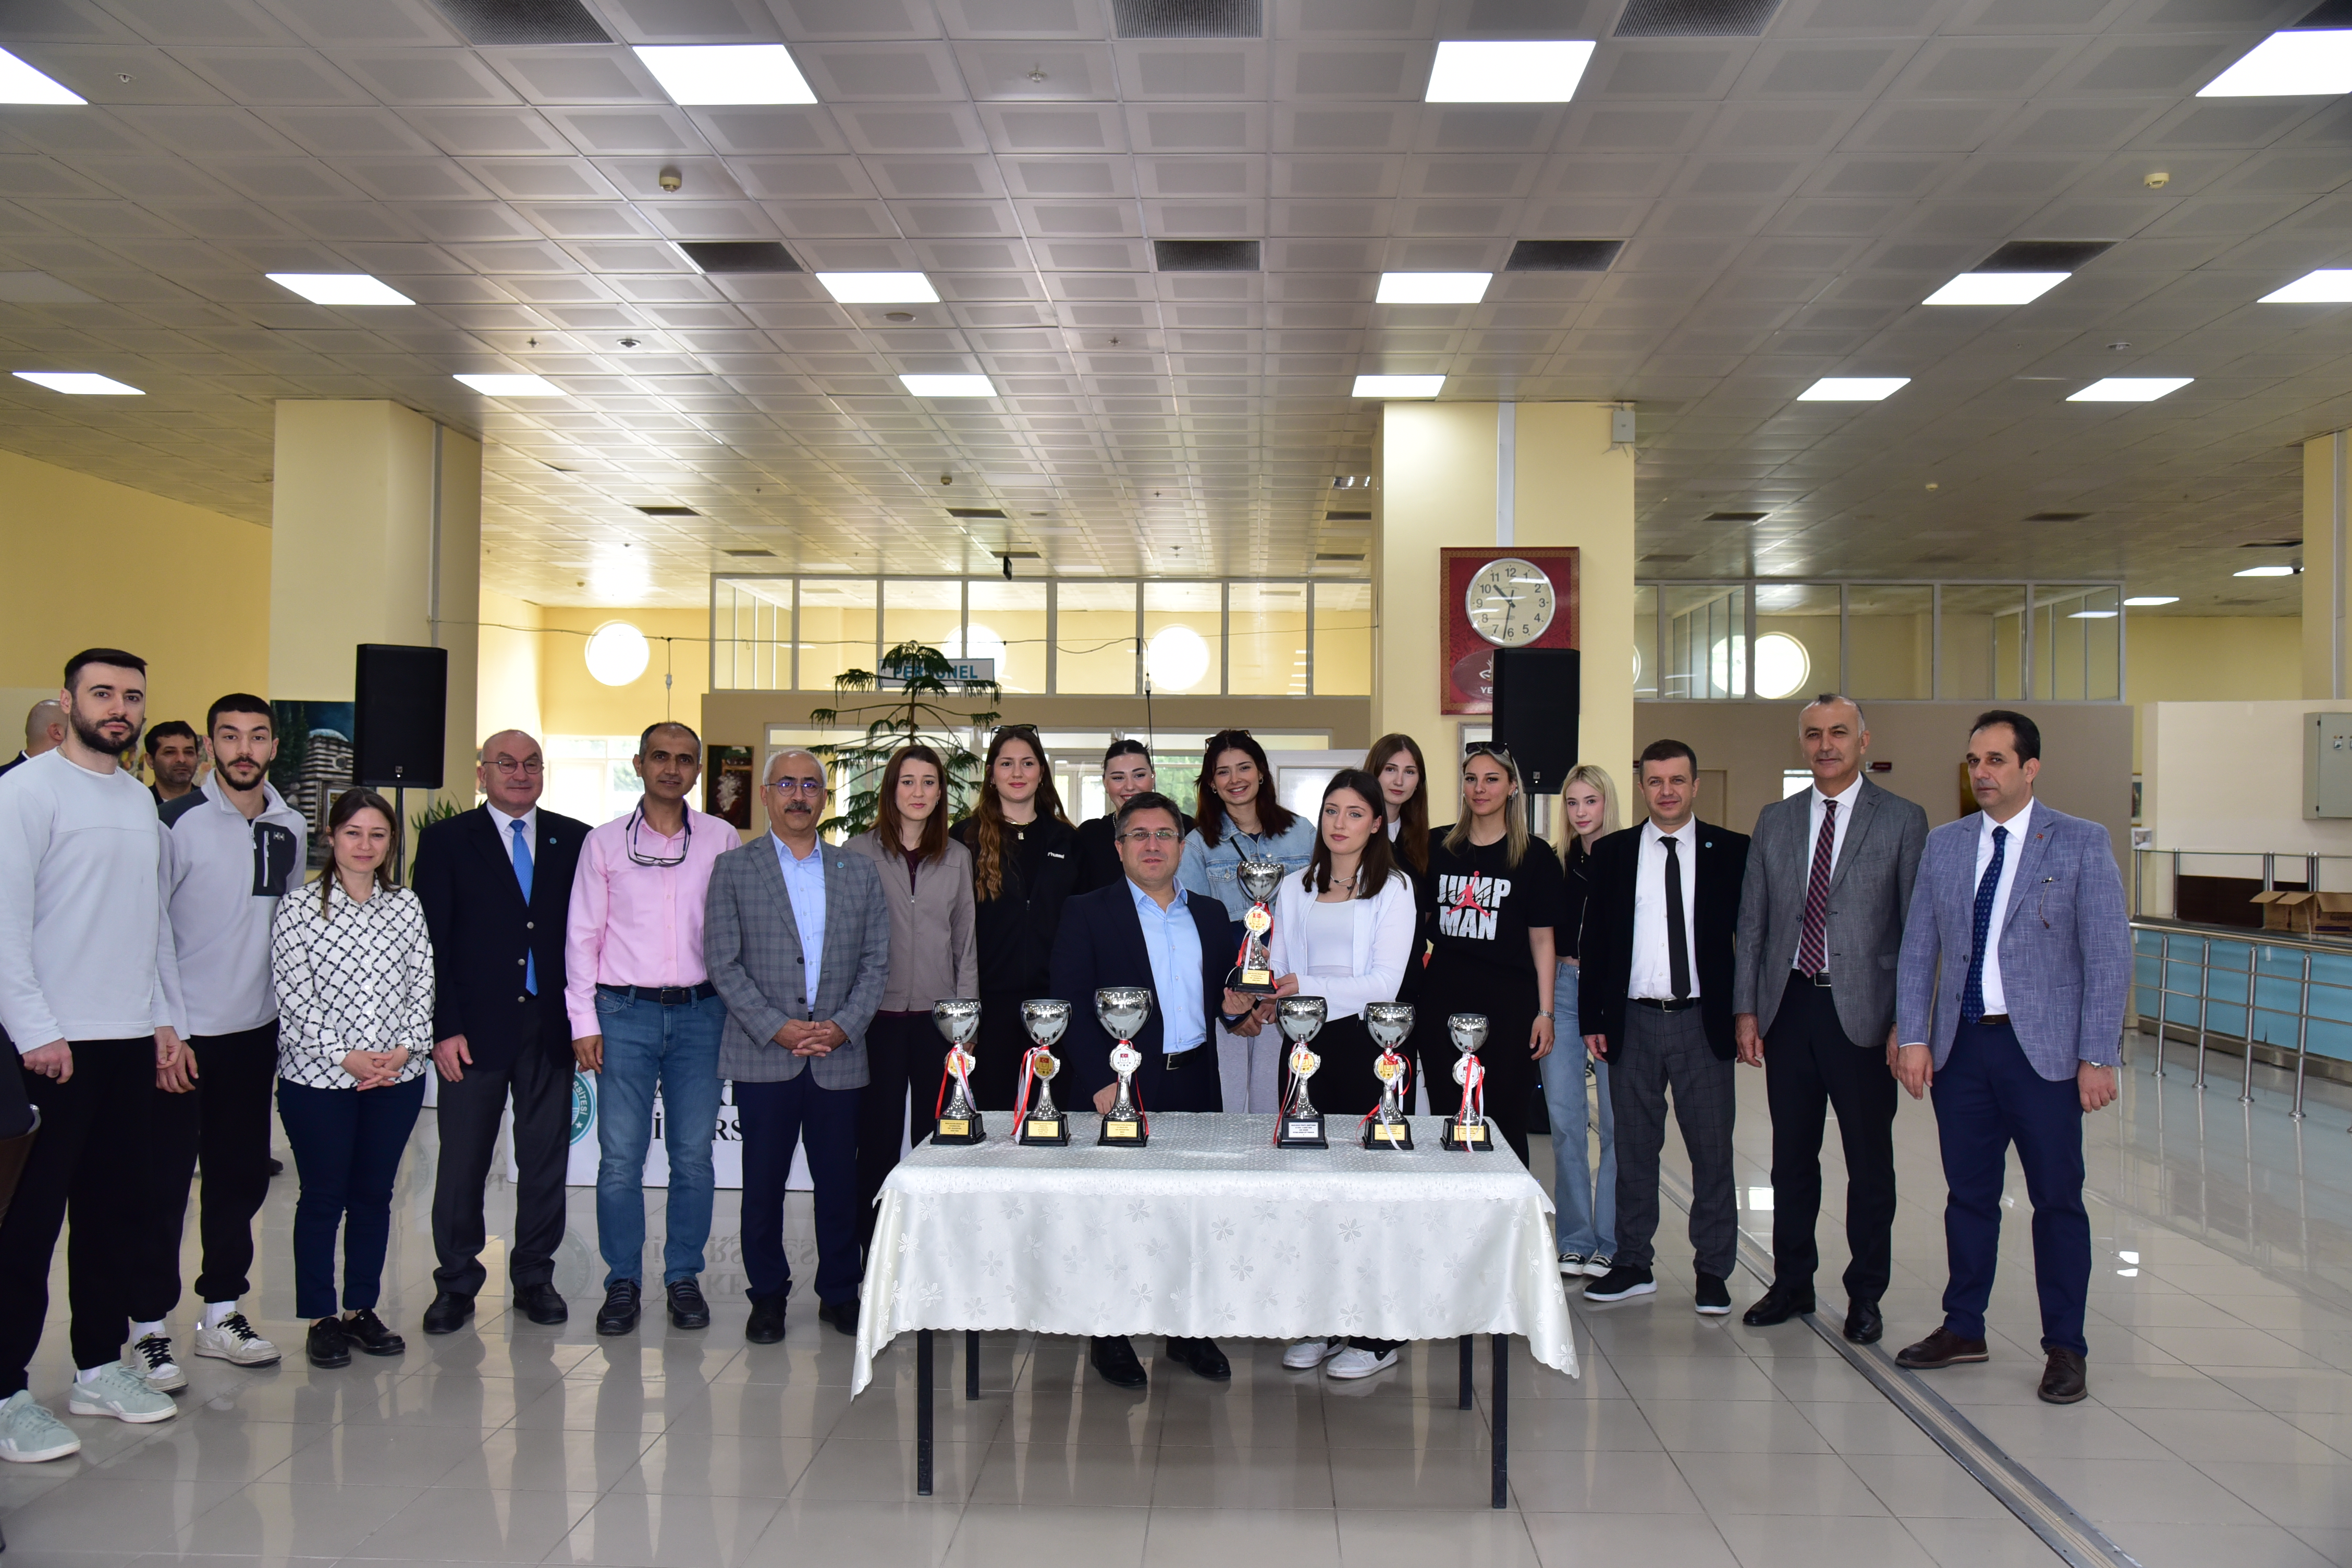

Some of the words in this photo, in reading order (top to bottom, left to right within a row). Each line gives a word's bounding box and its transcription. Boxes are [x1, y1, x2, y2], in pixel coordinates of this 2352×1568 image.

[1490, 572, 1499, 582] 11
[1505, 568, 1516, 577] 12
[1523, 572, 1528, 581] 1
[1480, 584, 1491, 594] 10
[1535, 584, 1541, 593] 2
[1476, 599, 1483, 608] 9
[1539, 599, 1546, 607] 3
[1481, 614, 1488, 623] 8
[1534, 614, 1540, 622] 4
[1492, 624, 1499, 633] 7
[1508, 628, 1514, 637] 6
[1523, 625, 1529, 633] 5
[1437, 874, 1511, 908] JUMP
[1439, 905, 1498, 940] MAN
